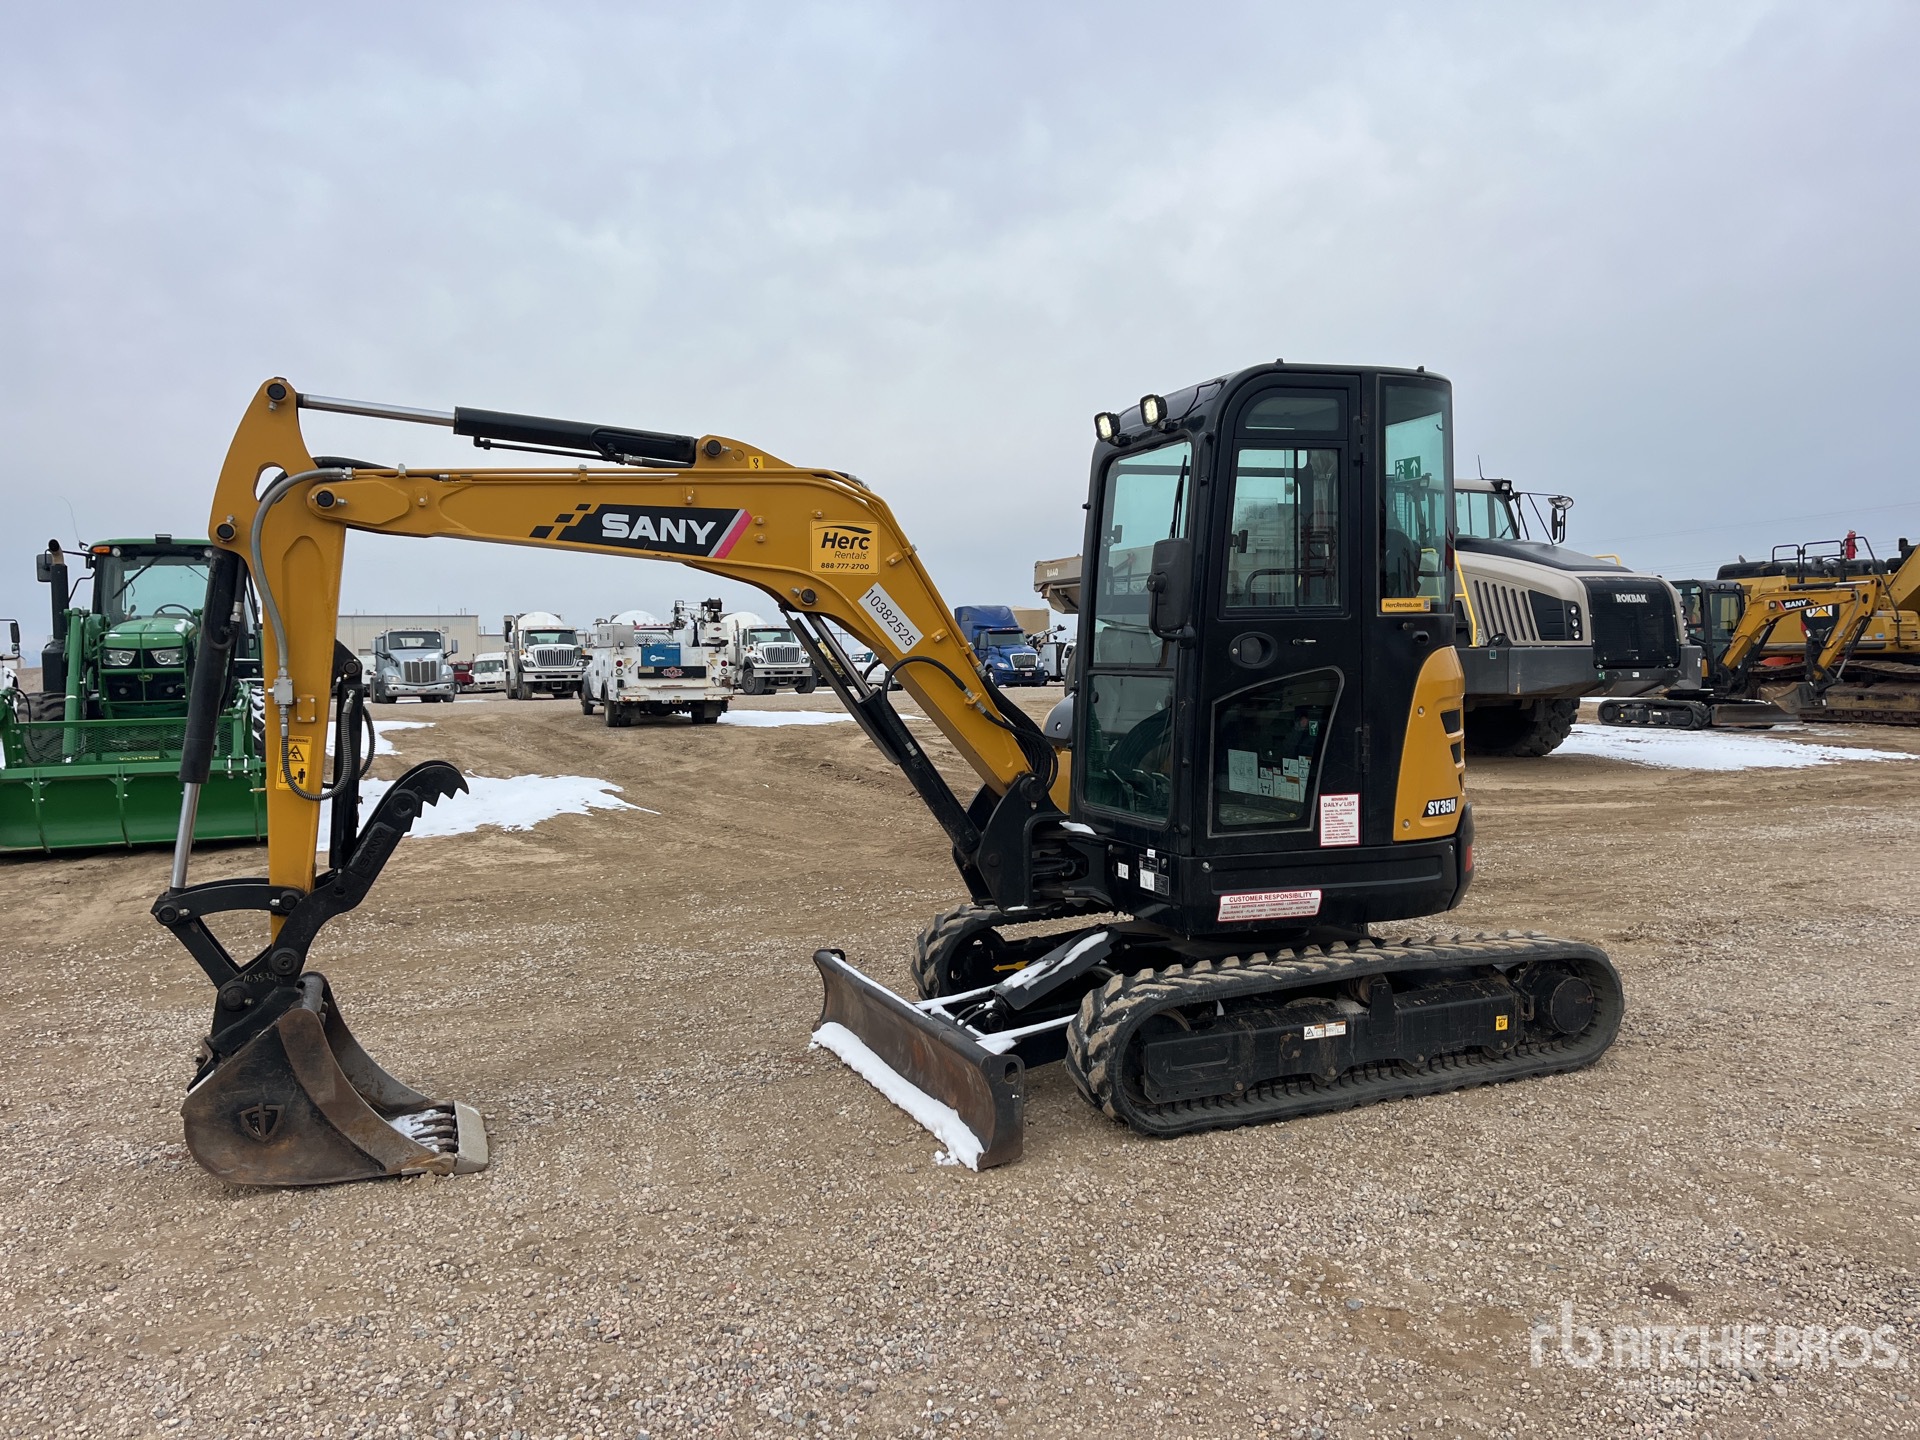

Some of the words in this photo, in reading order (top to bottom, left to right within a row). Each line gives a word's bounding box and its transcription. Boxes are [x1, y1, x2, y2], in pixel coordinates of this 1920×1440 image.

[602, 513, 716, 545] SANY
[821, 532, 871, 550] Herc
[834, 551, 867, 560] Rentals
[821, 562, 870, 570] 888-777-2700
[1615, 594, 1648, 603] ROKBAK
[1785, 600, 1807, 608] SANY
[866, 589, 916, 646] 10382525
[1428, 799, 1456, 815] SY35U
[1229, 895, 1263, 903] CUSTOMER
[1264, 892, 1313, 901] RESPONSIBILITY
